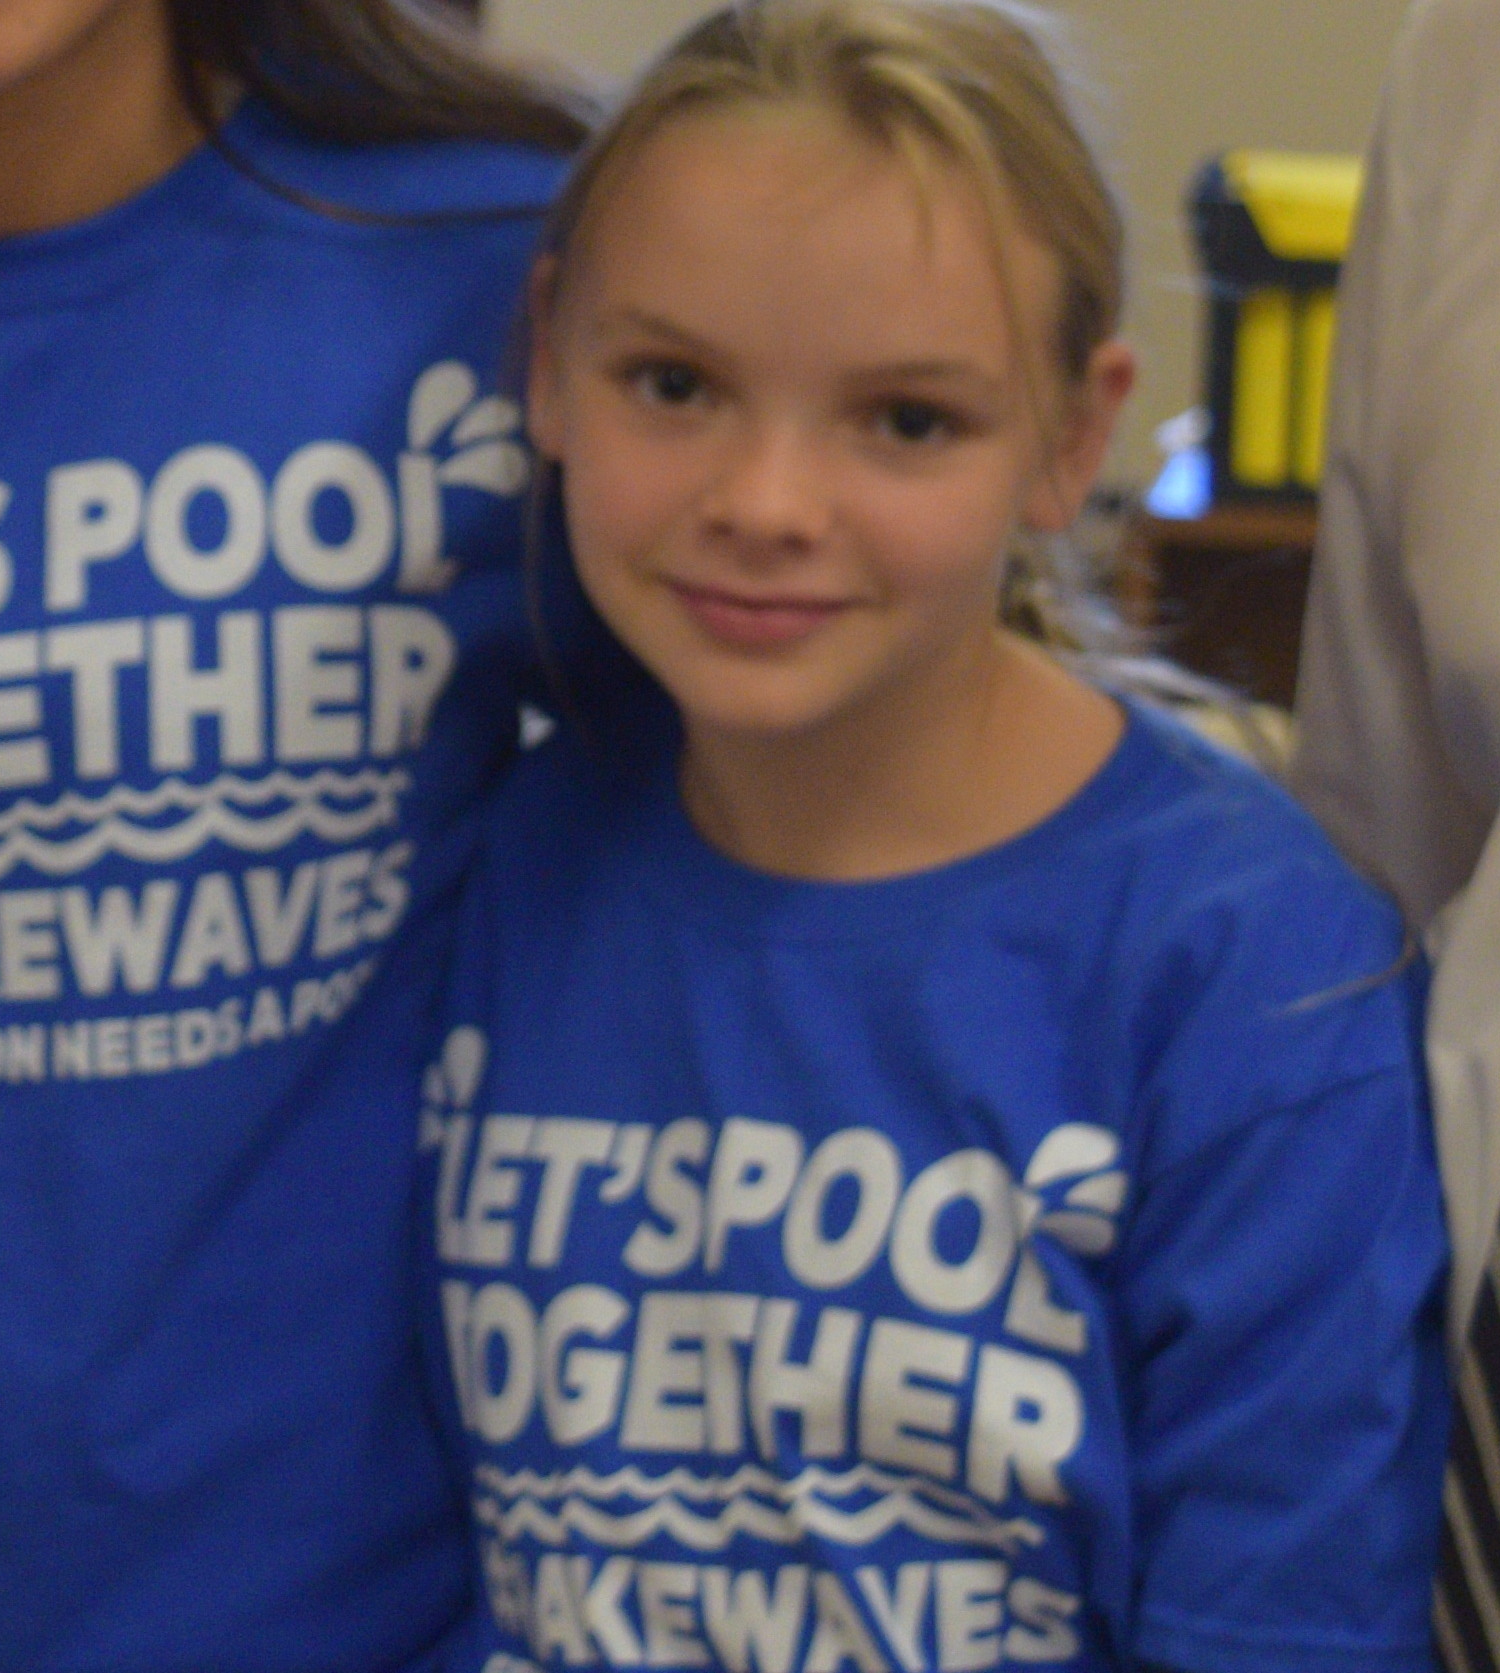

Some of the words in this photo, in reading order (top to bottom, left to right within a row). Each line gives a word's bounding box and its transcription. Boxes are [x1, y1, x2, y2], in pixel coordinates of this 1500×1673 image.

[53, 997, 244, 1082] NEEDS
[246, 986, 286, 1046] A
[436, 1114, 712, 1278] LET’S
